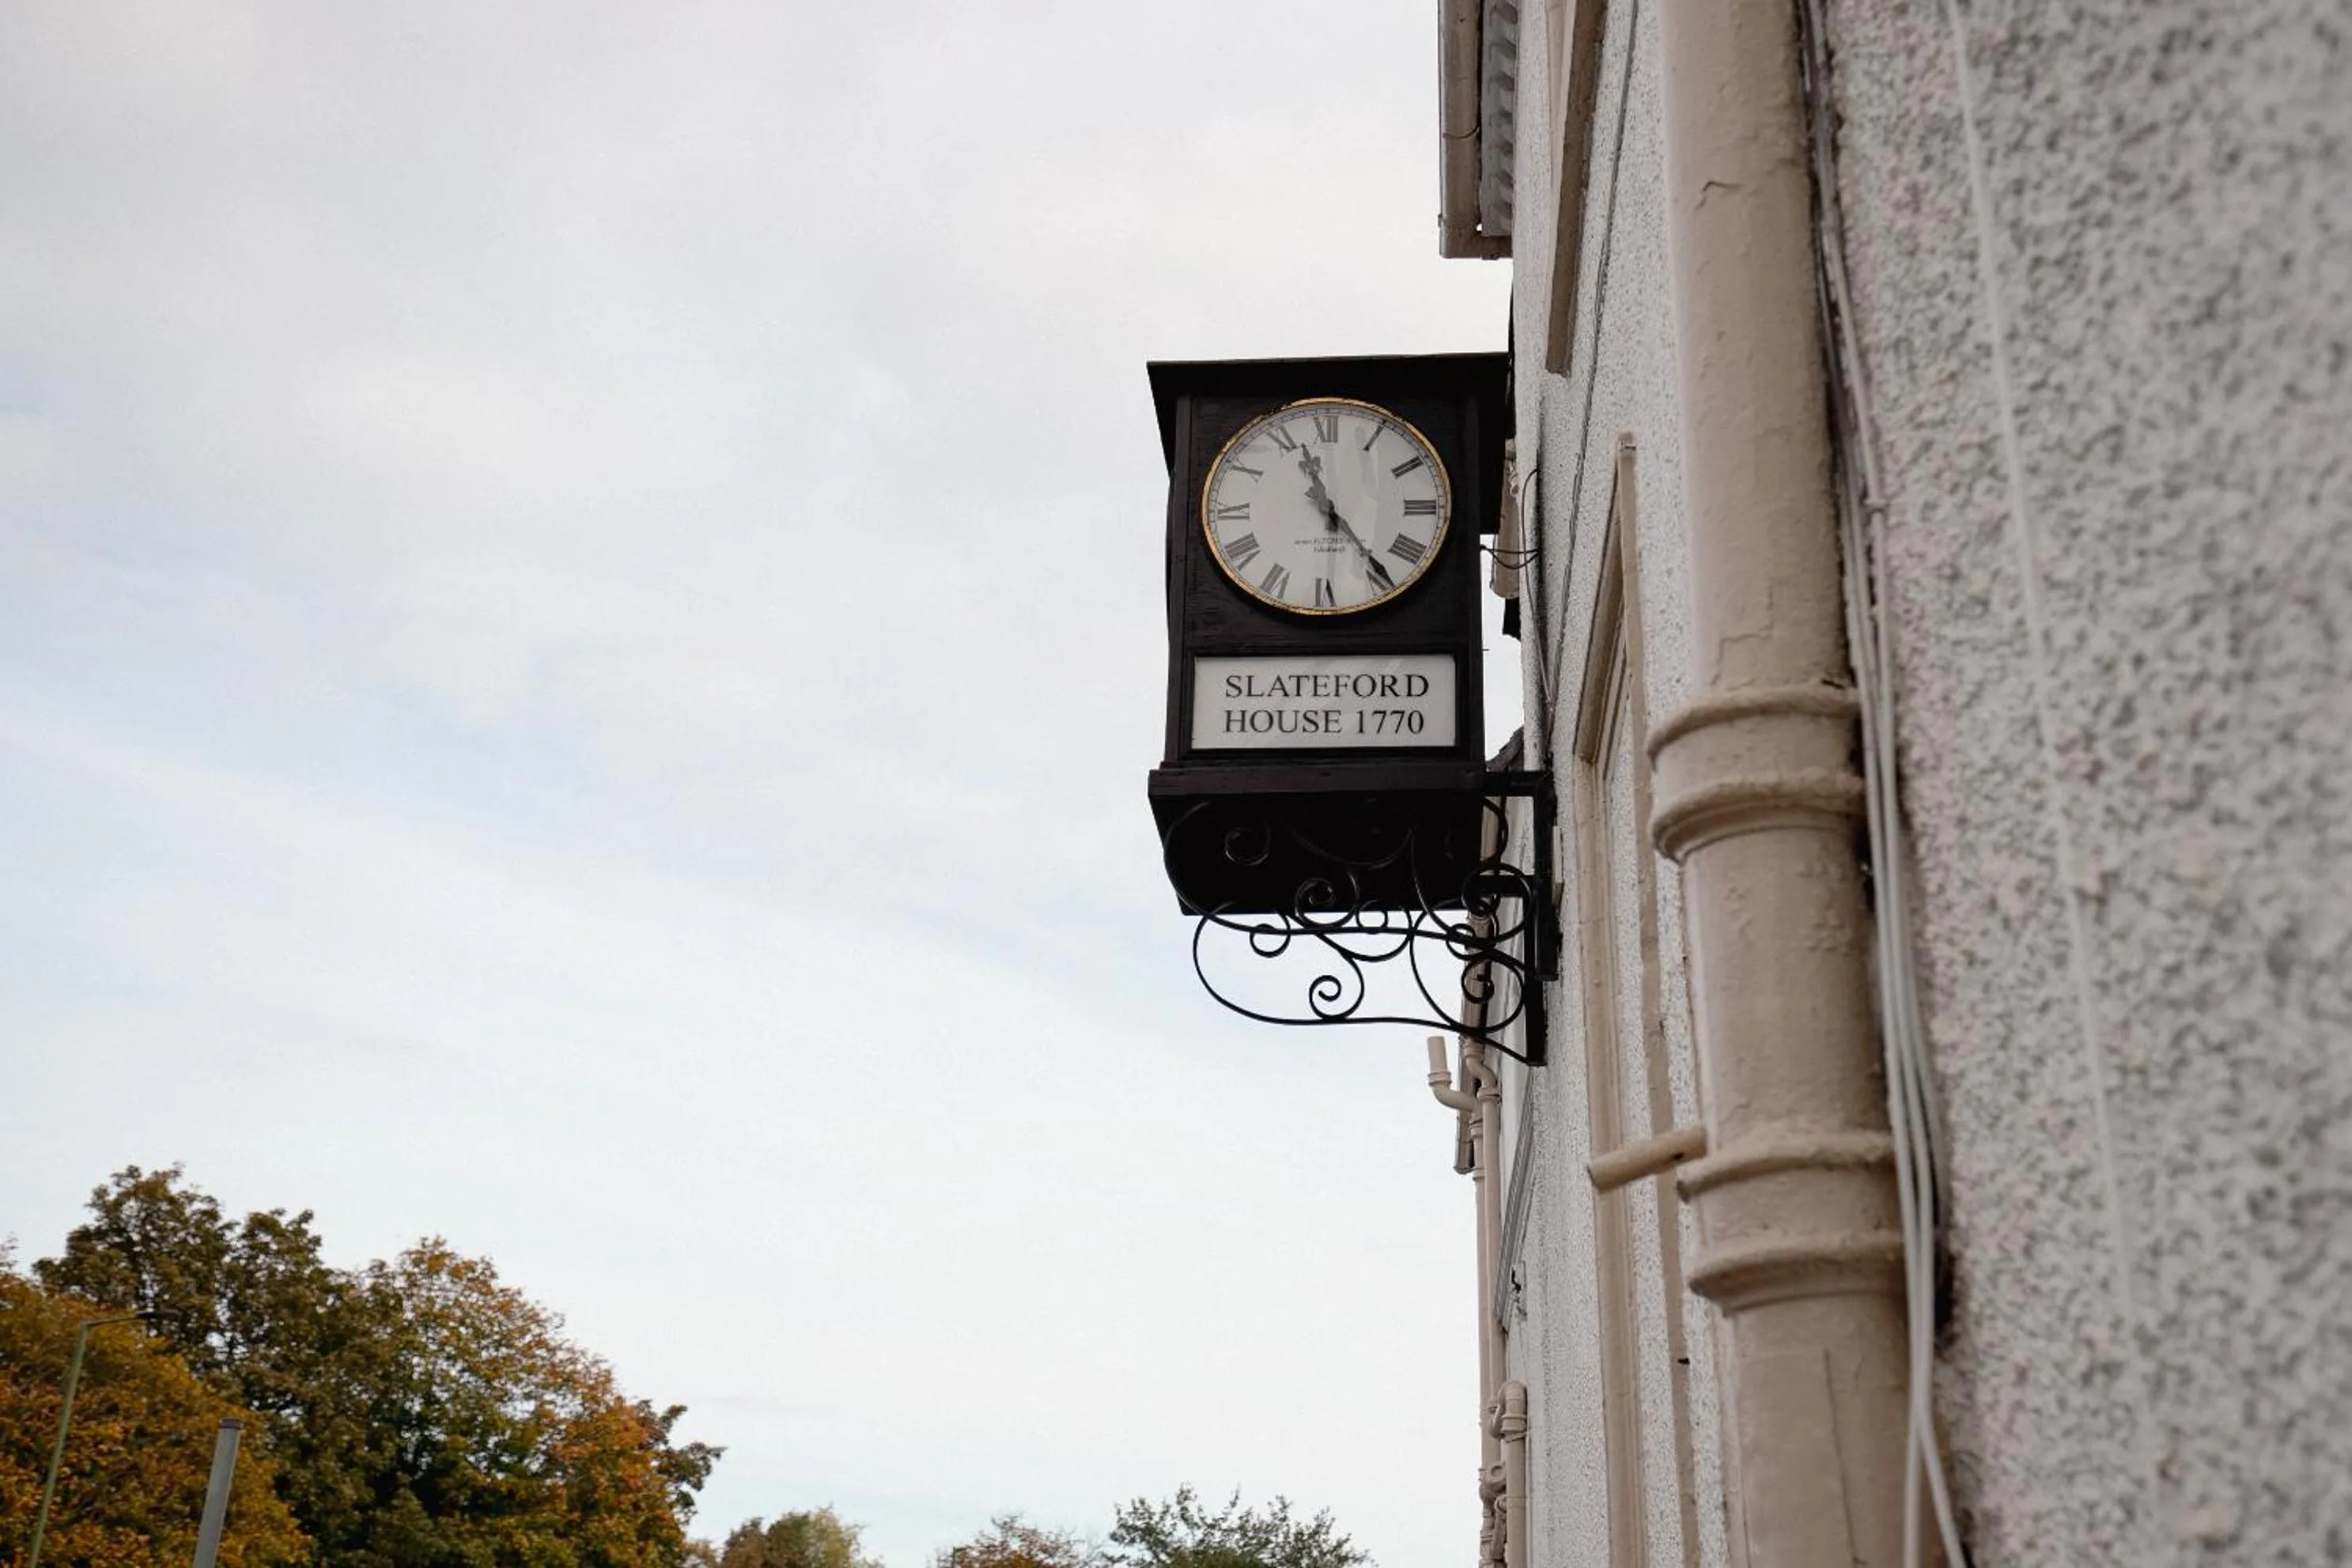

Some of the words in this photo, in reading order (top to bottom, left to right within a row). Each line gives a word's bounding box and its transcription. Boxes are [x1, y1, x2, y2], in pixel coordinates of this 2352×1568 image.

[1310, 414, 1339, 445] XII
[1390, 454, 1425, 479] II
[1403, 499, 1438, 516] III
[1224, 674, 1430, 698] SLATEFORD
[1224, 709, 1343, 735] HOUSE
[1356, 710, 1425, 735] 1770
